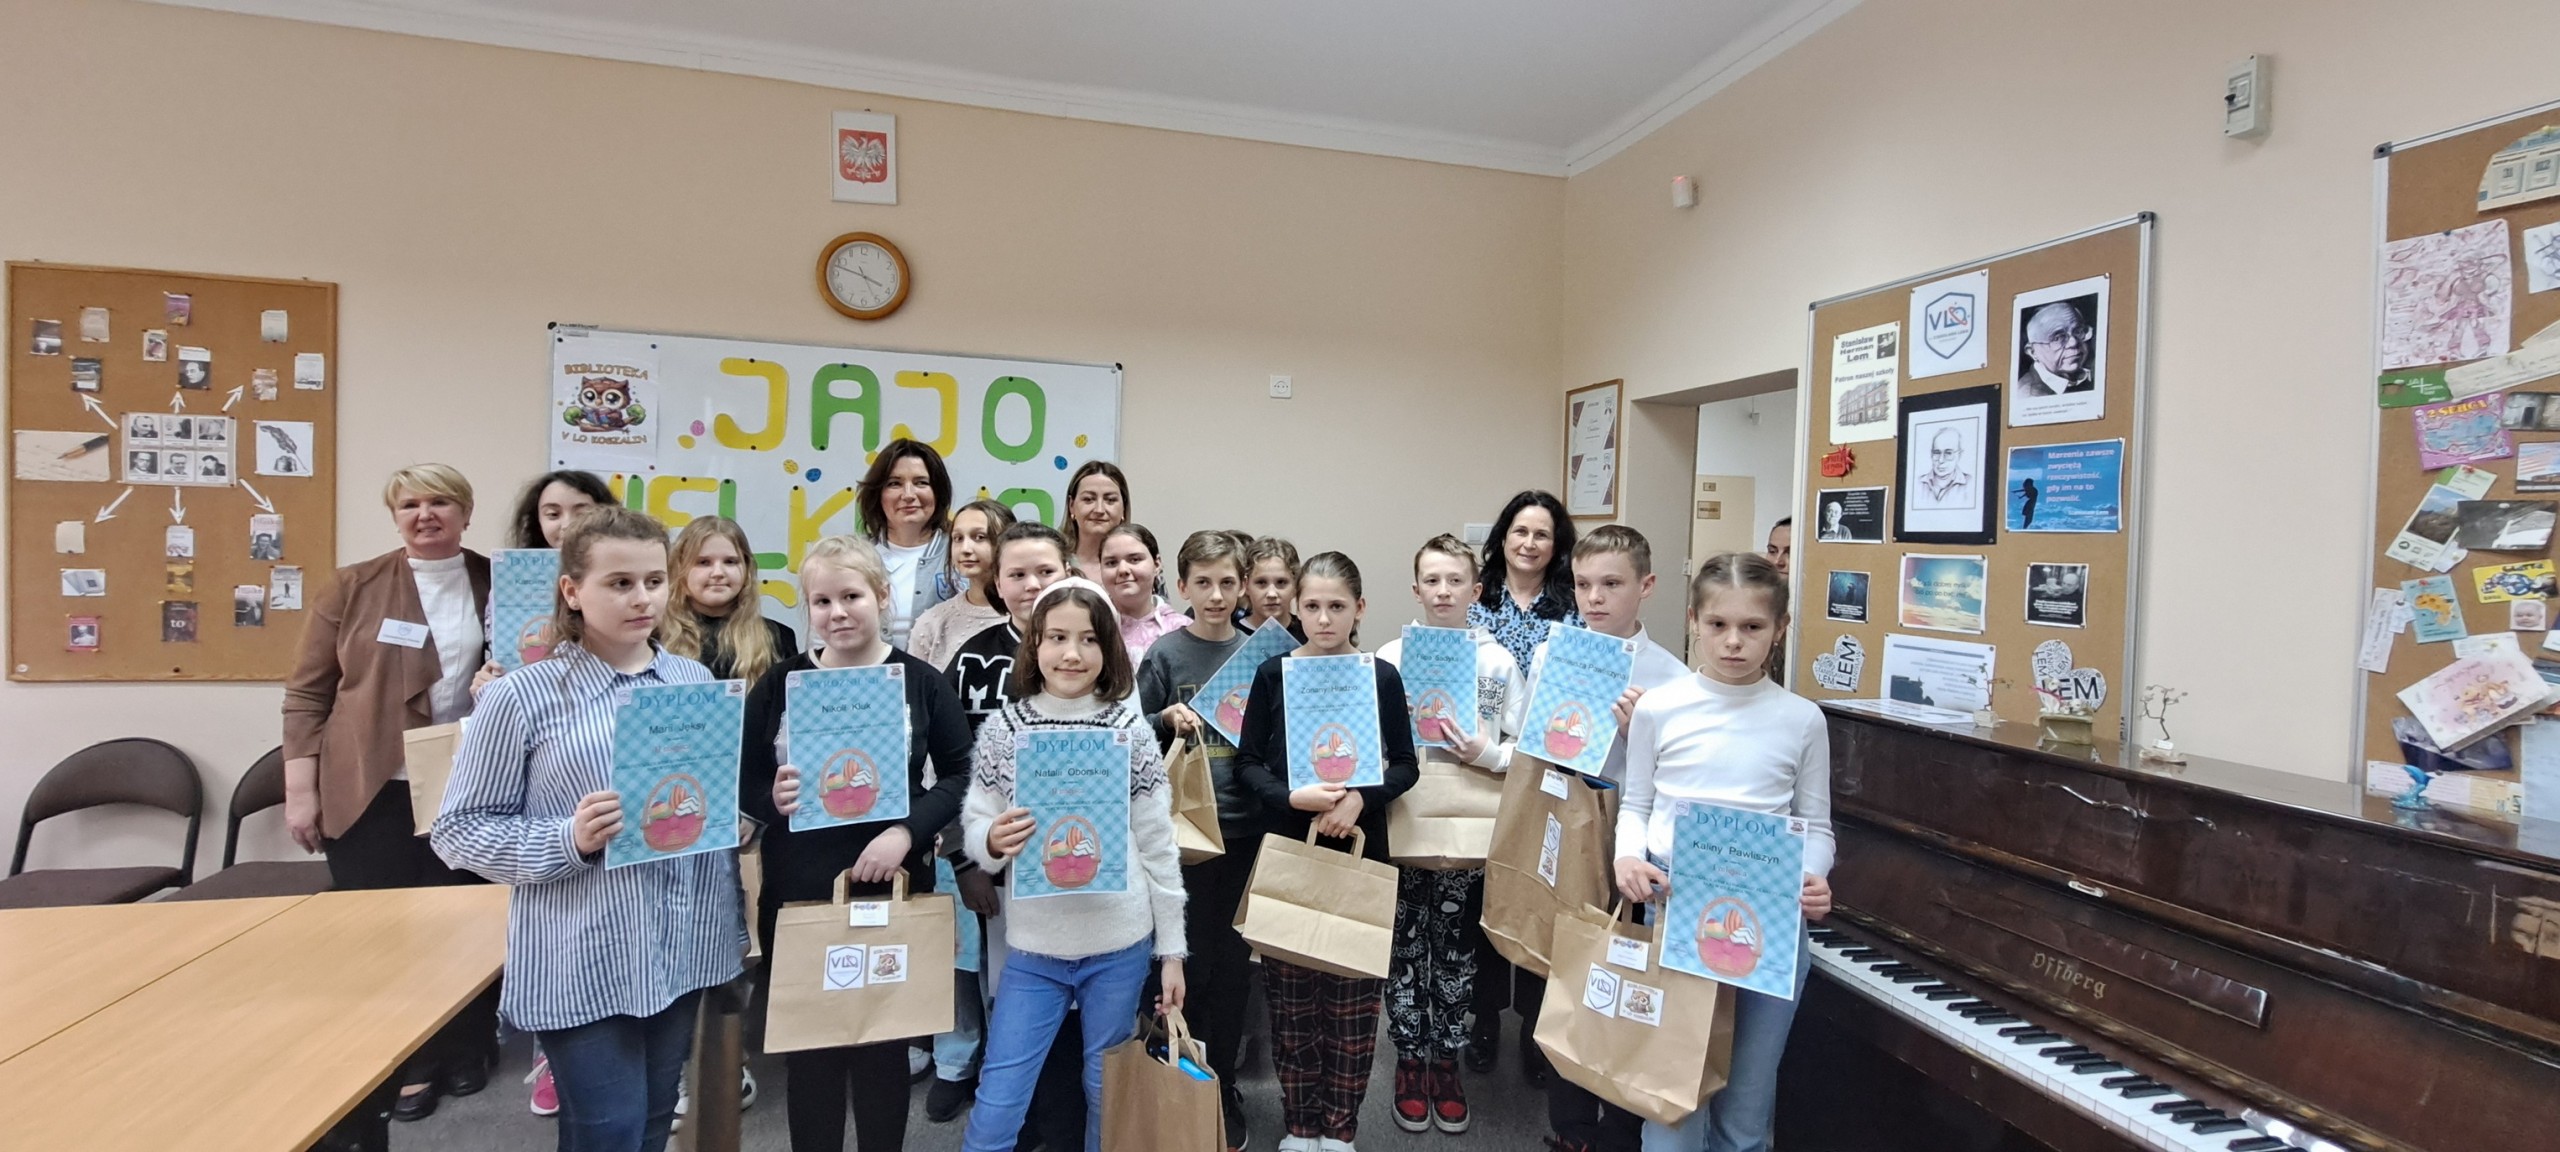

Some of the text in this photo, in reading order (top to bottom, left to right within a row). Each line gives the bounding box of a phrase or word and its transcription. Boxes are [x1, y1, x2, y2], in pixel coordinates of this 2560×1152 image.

[1840, 344, 1874, 355] Herman
[1841, 336, 1875, 348] Stanisław
[1847, 352, 1869, 362] Lem
[564, 363, 648, 380] BIBLIOTEKA
[561, 431, 648, 445] V LO KOSZALIN
[2048, 449, 2115, 459] Marzenia zawsze
[2046, 484, 2060, 493] gdy
[170, 619, 186, 628] to
[1415, 633, 1461, 645] DYPLOM
[1564, 633, 1616, 656] DYPLOM
[1836, 640, 1857, 687] LEM
[2035, 650, 2047, 677] LEM
[957, 653, 1016, 714] M
[639, 690, 717, 710] DYPLOM
[649, 724, 673, 735] Marii
[1036, 738, 1106, 754] DYPLOM
[1696, 811, 1776, 837] DYPLOM
[1692, 840, 1780, 865] Kaliny Pawliszyn
[2031, 951, 2107, 998] Offberg
